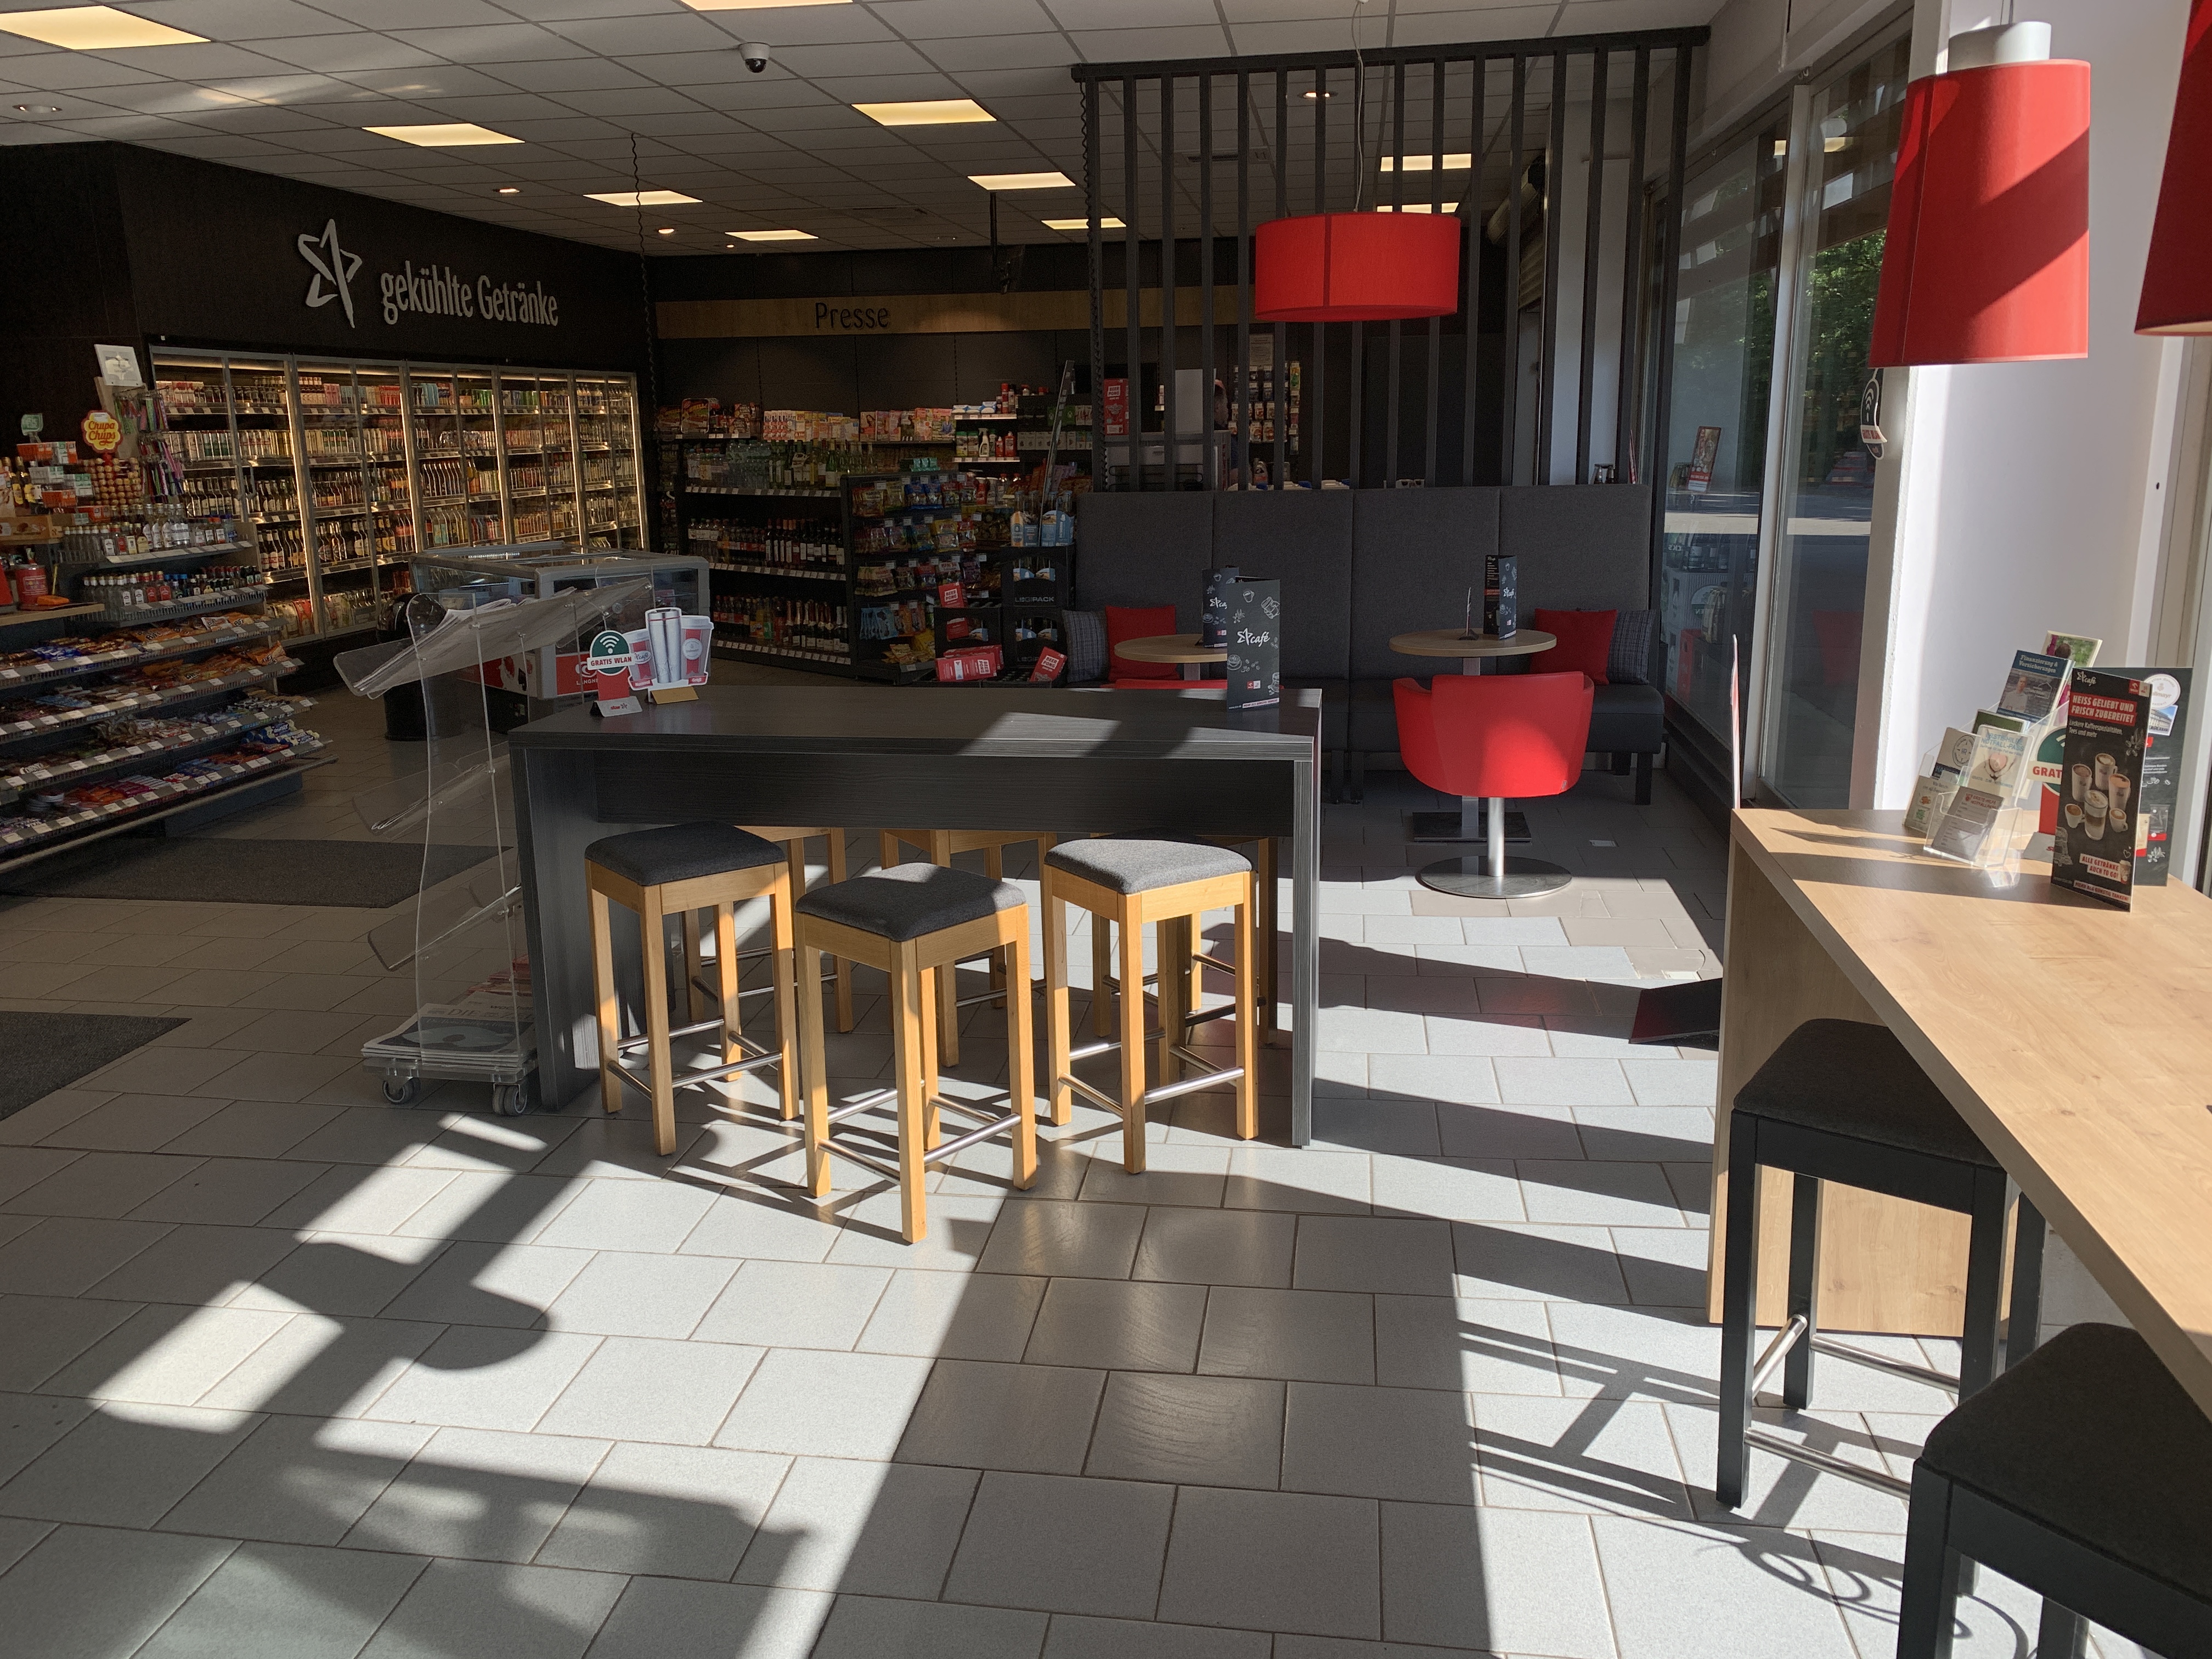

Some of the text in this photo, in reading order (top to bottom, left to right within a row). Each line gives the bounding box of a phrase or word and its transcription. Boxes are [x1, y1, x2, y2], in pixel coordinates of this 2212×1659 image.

[381, 260, 558, 326] gekühlte Getränke
[815, 302, 889, 328] Presse
[88, 421, 115, 432] Chupa
[89, 430, 116, 446] Chups
[1250, 631, 1270, 647] café
[591, 658, 612, 667] GRATIS
[1043, 661, 1056, 669] PONG
[1045, 656, 1058, 664] BEER
[2020, 654, 2053, 667] Finanzierung
[2019, 661, 2056, 673] Versicherungen
[2085, 676, 2097, 686] café
[2072, 695, 2134, 713] HEISS GELIEBT UND
[2071, 705, 2135, 724] FRISCH ZUBEREITET
[2069, 720, 2084, 728] Leckere
[1981, 737, 2024, 752] NOTFALL-PASS
[2033, 766, 2062, 778] GRAT
[2081, 856, 2119, 871] ALLE GETRÄNKE
[2089, 866, 2103, 874] AUCH
